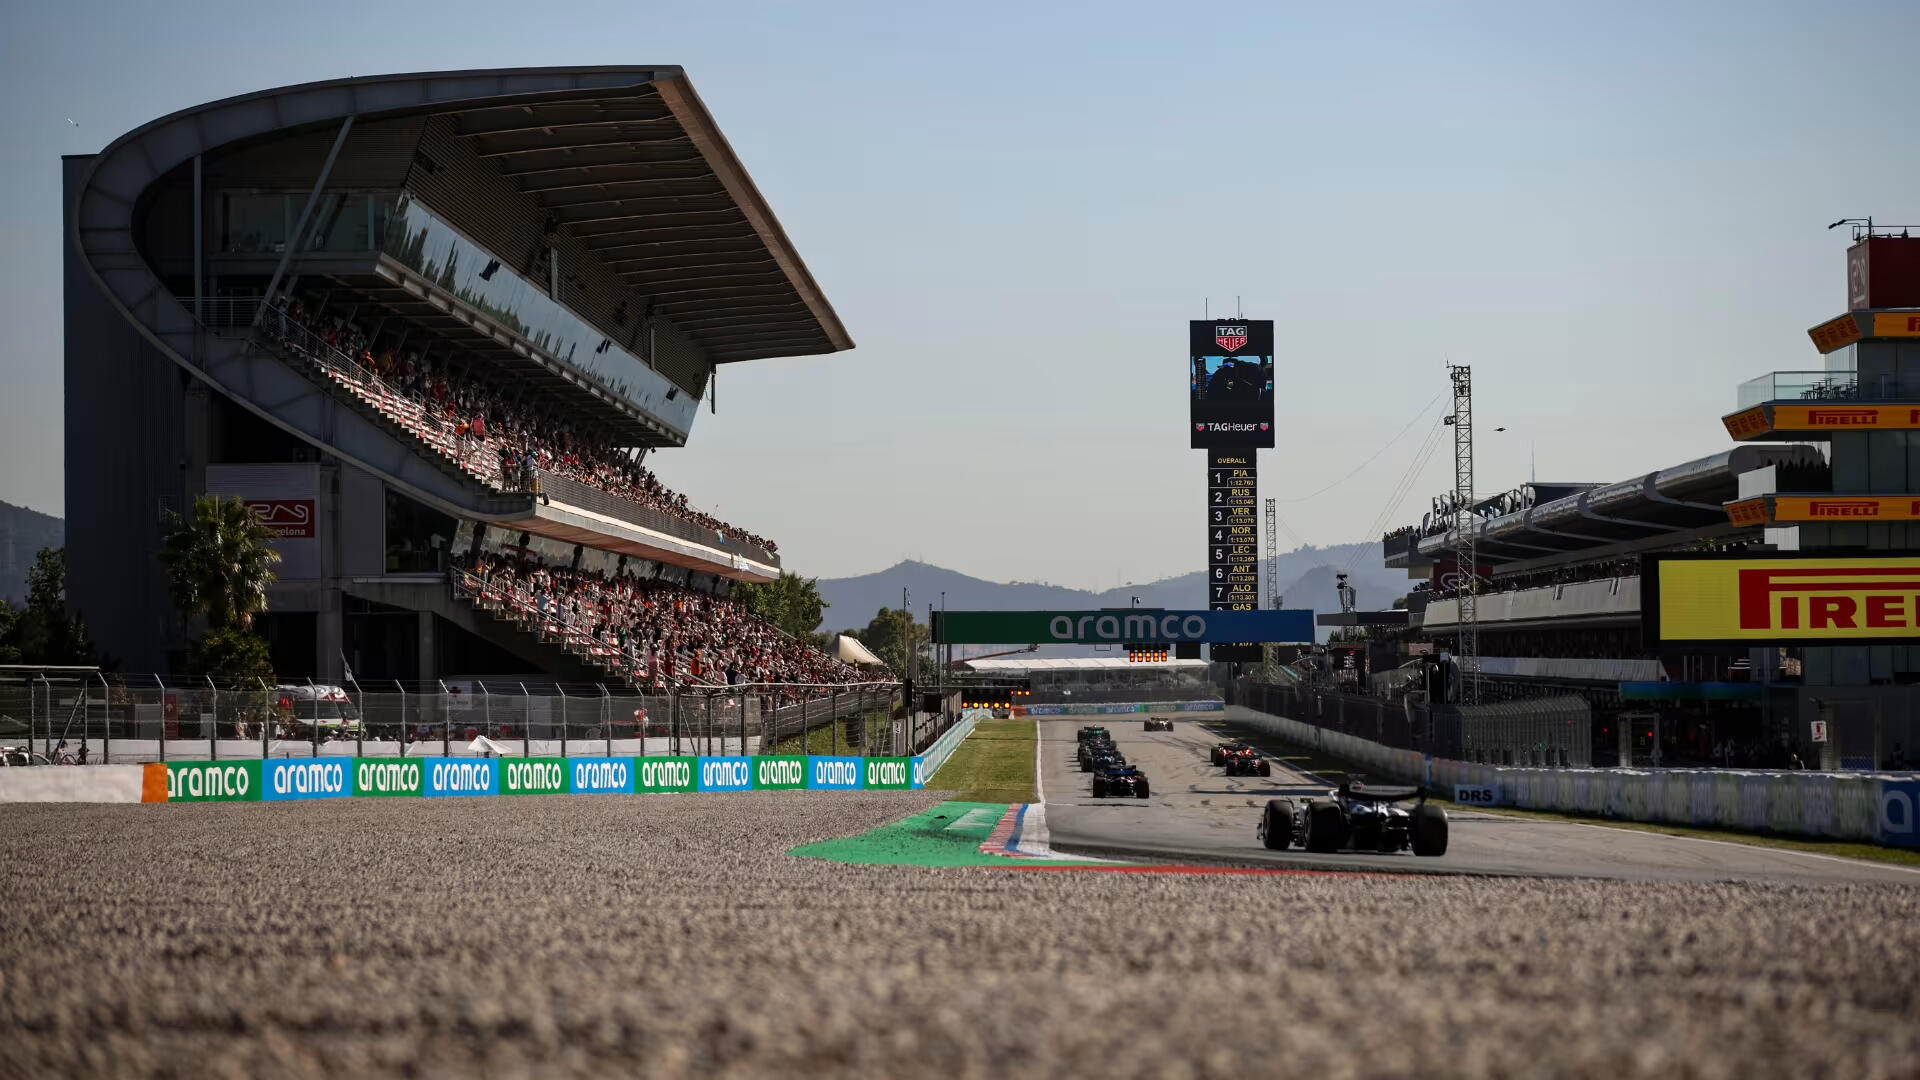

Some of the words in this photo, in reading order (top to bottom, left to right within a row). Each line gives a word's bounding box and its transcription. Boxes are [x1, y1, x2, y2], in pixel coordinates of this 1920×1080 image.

[1218, 337, 1245, 350] HEUER
[1808, 410, 1878, 425] PIRELLI
[1215, 473, 1220, 483] 1
[1215, 492, 1222, 502] 2
[1809, 501, 1879, 516] PIRELLI
[1215, 511, 1222, 521] 3
[1215, 530, 1222, 540] 4
[1215, 549, 1223, 559] 5
[1215, 568, 1223, 578] 6
[1216, 587, 1223, 598] 7
[1739, 567, 1920, 630] PIRE
[1050, 615, 1206, 639] aramco
[168, 767, 249, 797] aramco
[274, 764, 343, 794] aramco
[359, 764, 419, 791] aramco
[433, 764, 489, 791] aramco
[508, 763, 562, 790] aramco
[576, 763, 627, 789] aramco
[642, 762, 690, 787] aramco
[703, 762, 749, 787] aramco
[759, 761, 802, 785] aramco
[816, 762, 857, 785] aramco
[868, 762, 906, 785] aramco
[1459, 789, 1493, 802] DRS
